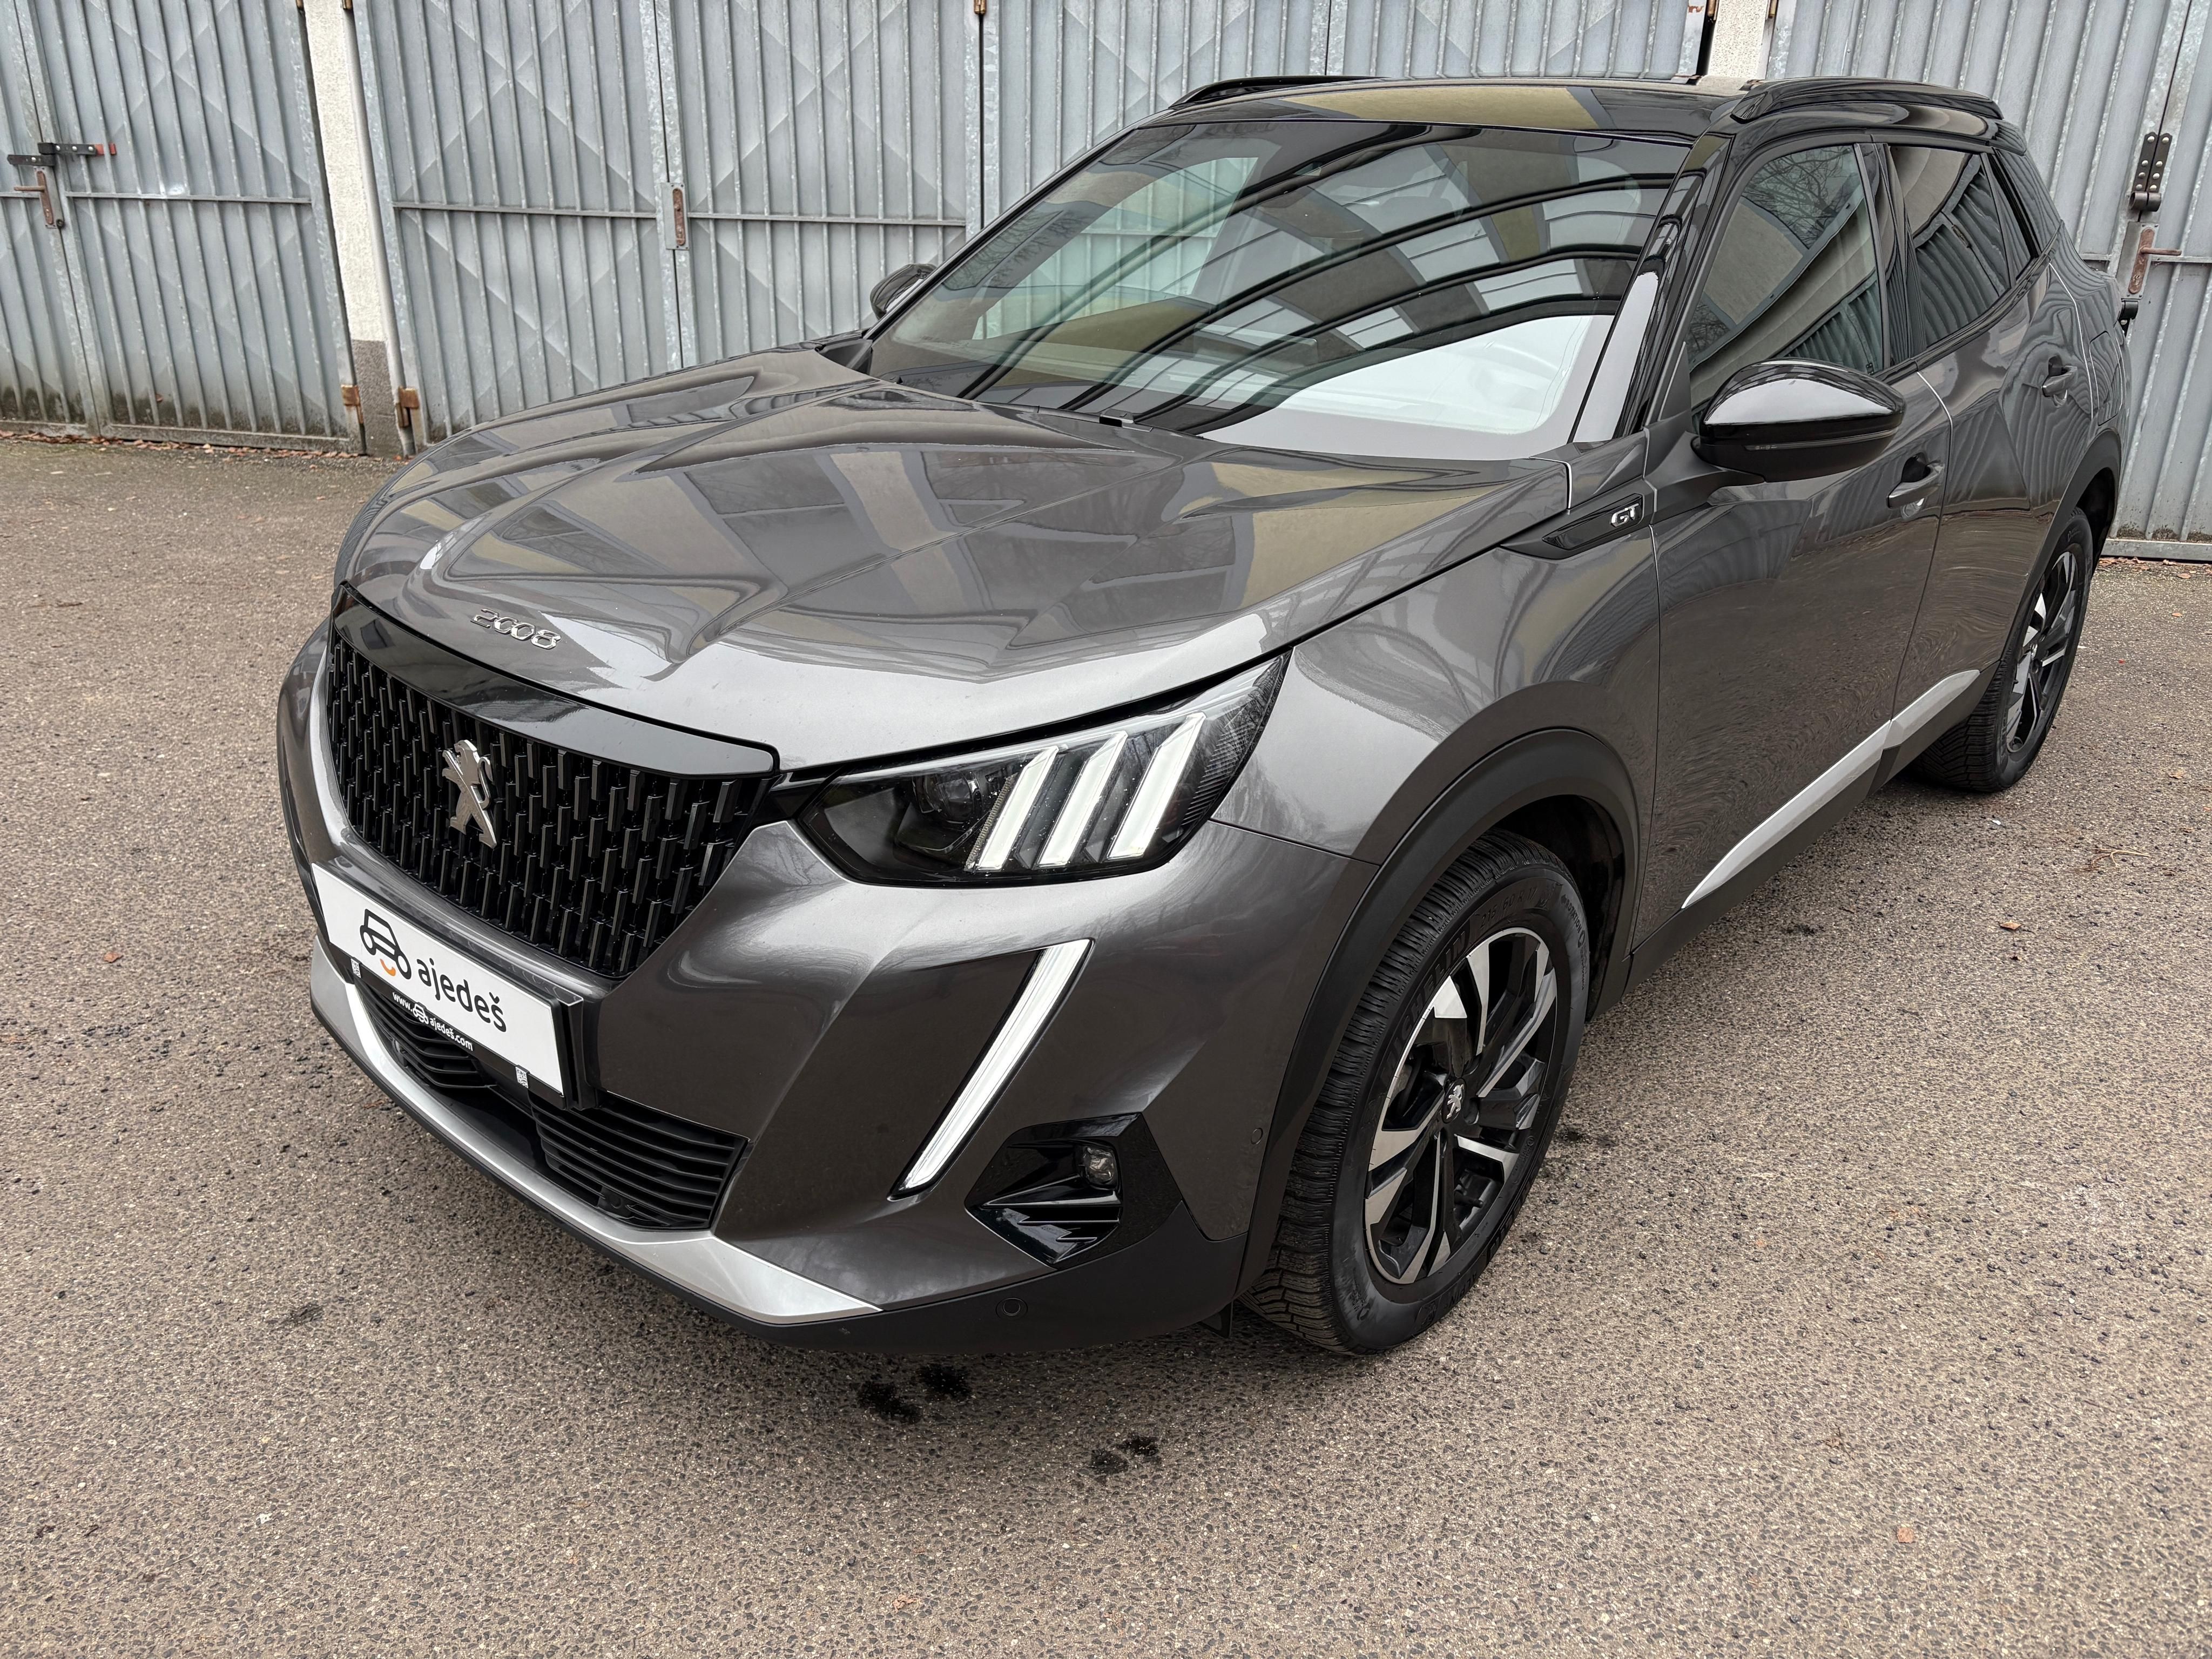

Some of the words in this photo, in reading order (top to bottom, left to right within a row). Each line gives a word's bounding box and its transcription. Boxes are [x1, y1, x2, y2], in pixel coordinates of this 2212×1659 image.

[1611, 503, 1639, 527] GT
[470, 609, 562, 650] 2008
[1566, 899, 1582, 934] ROTATION
[417, 958, 507, 1032] ajedeš
[1380, 929, 1466, 1085] MICHELIN
